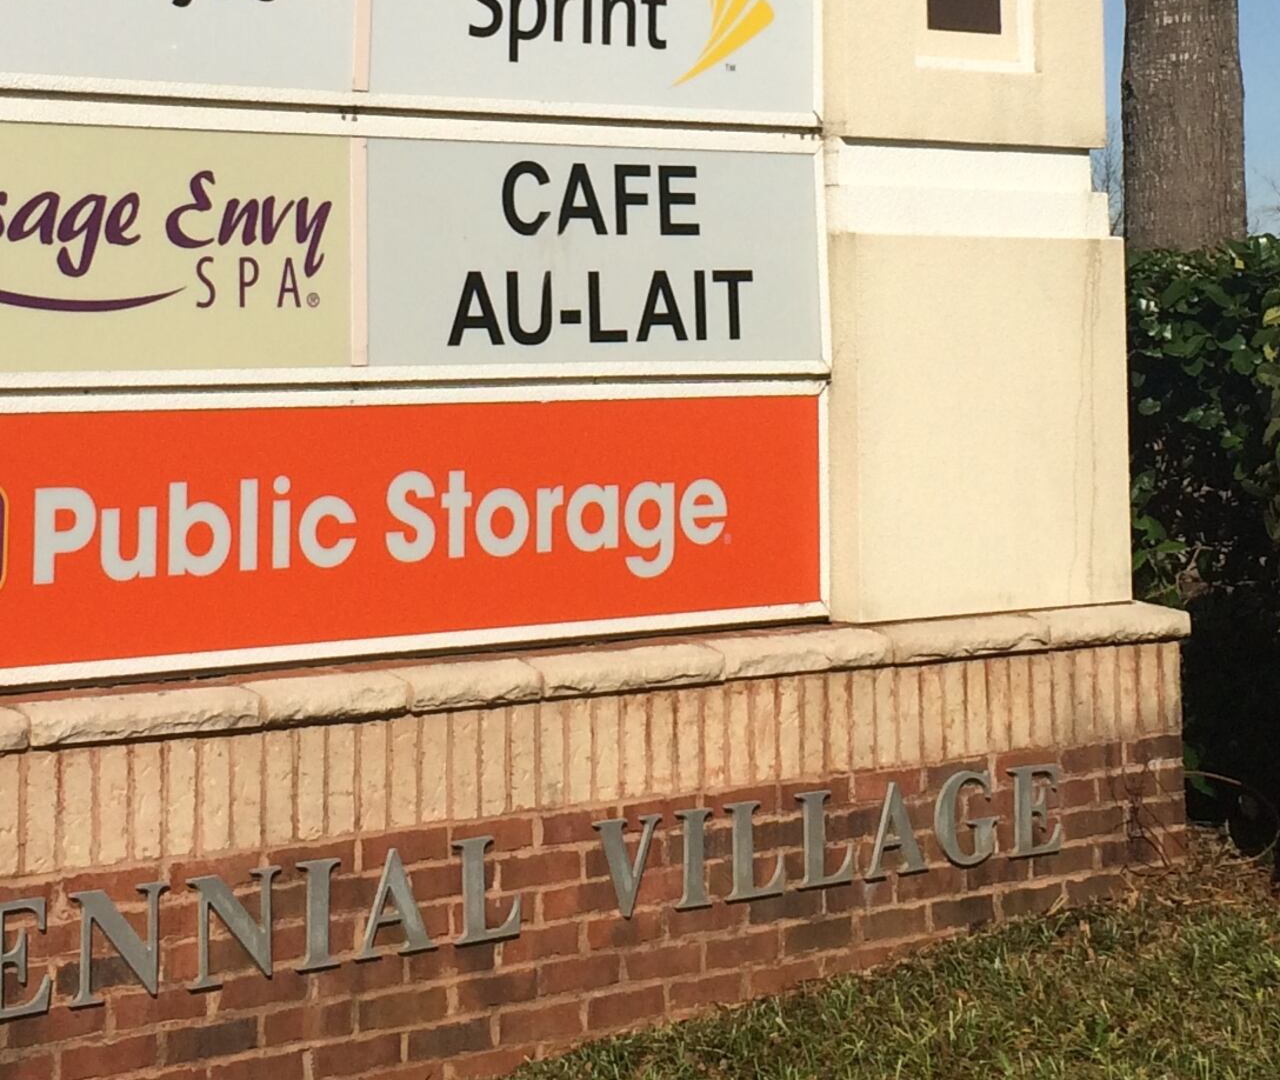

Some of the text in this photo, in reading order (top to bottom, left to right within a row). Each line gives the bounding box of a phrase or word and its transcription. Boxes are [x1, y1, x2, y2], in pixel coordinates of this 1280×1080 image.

[165, 170, 333, 278] Envy
[501, 160, 701, 237] CAFE
[195, 255, 302, 309] SPA
[447, 269, 754, 347] AU-LAIT
[33, 469, 729, 586] Public Storage
[592, 763, 1063, 919] VILLAGE
